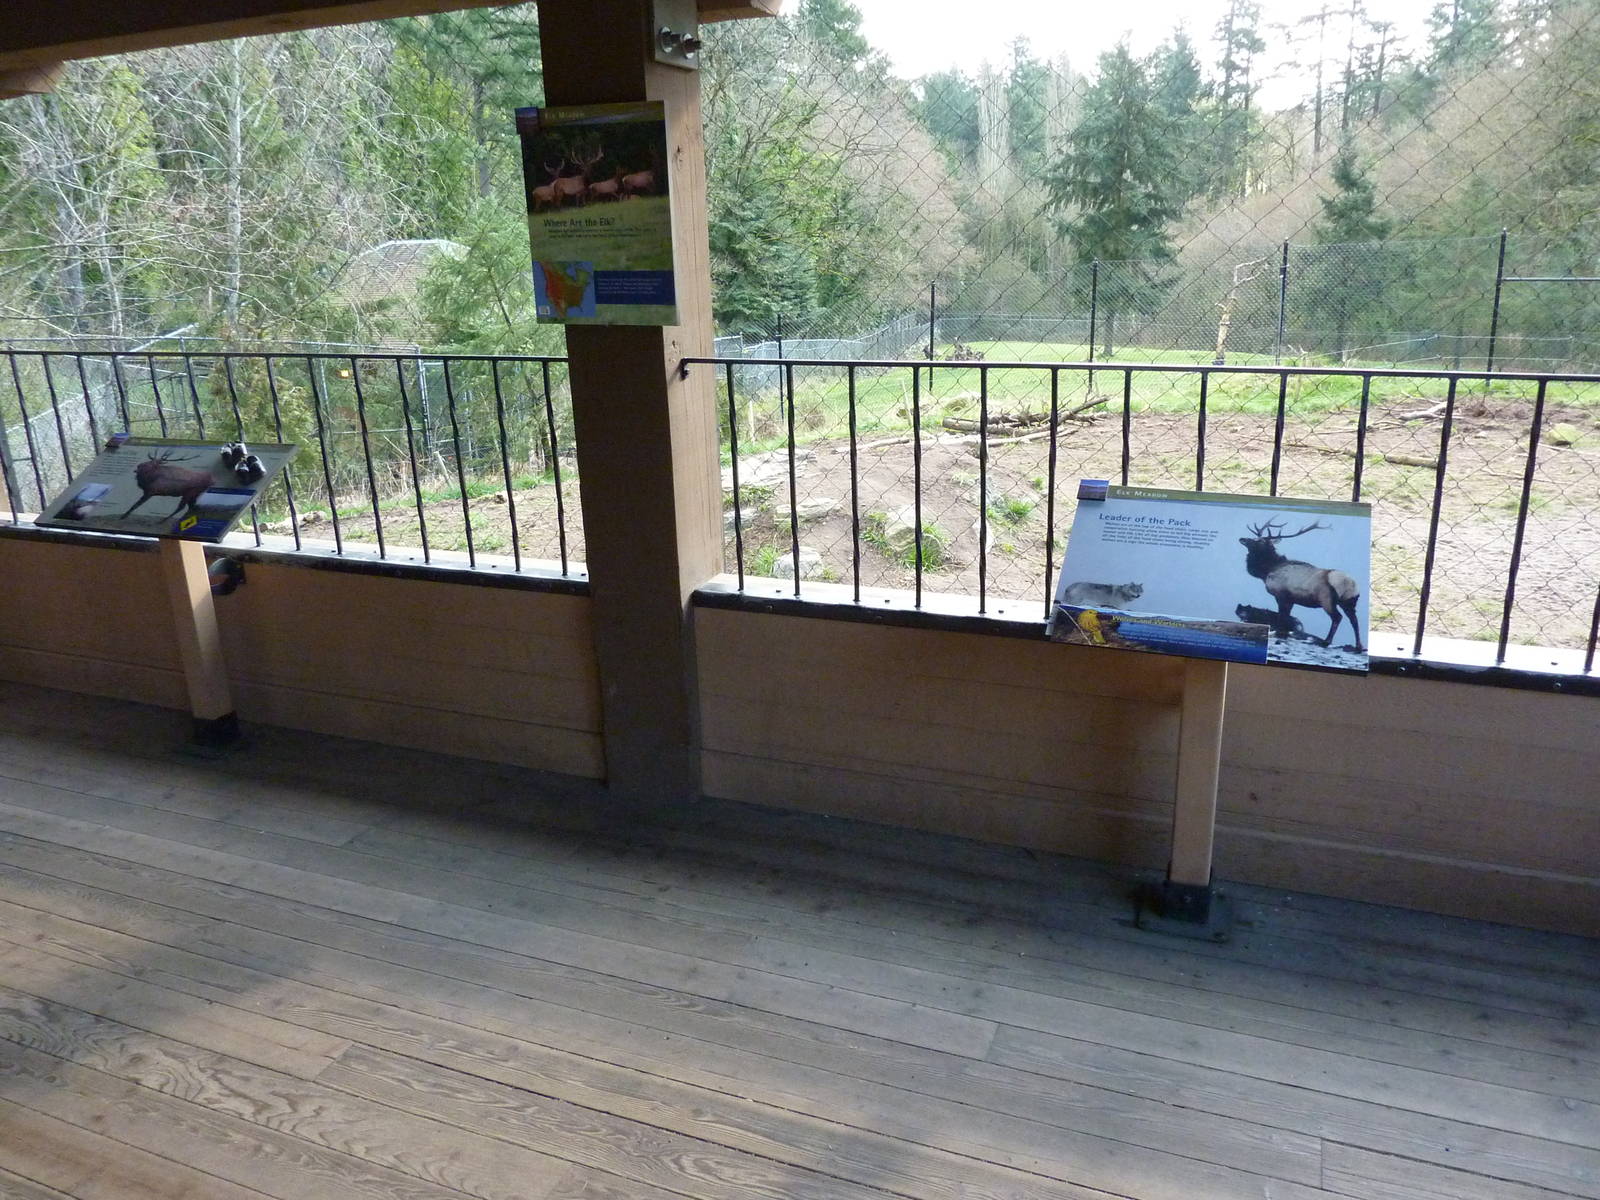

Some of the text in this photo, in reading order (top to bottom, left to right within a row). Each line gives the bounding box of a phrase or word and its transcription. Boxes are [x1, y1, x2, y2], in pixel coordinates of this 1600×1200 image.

[543, 217, 568, 227] Where
[585, 216, 598, 227] the
[1099, 513, 1192, 527] Leader of the Pack
